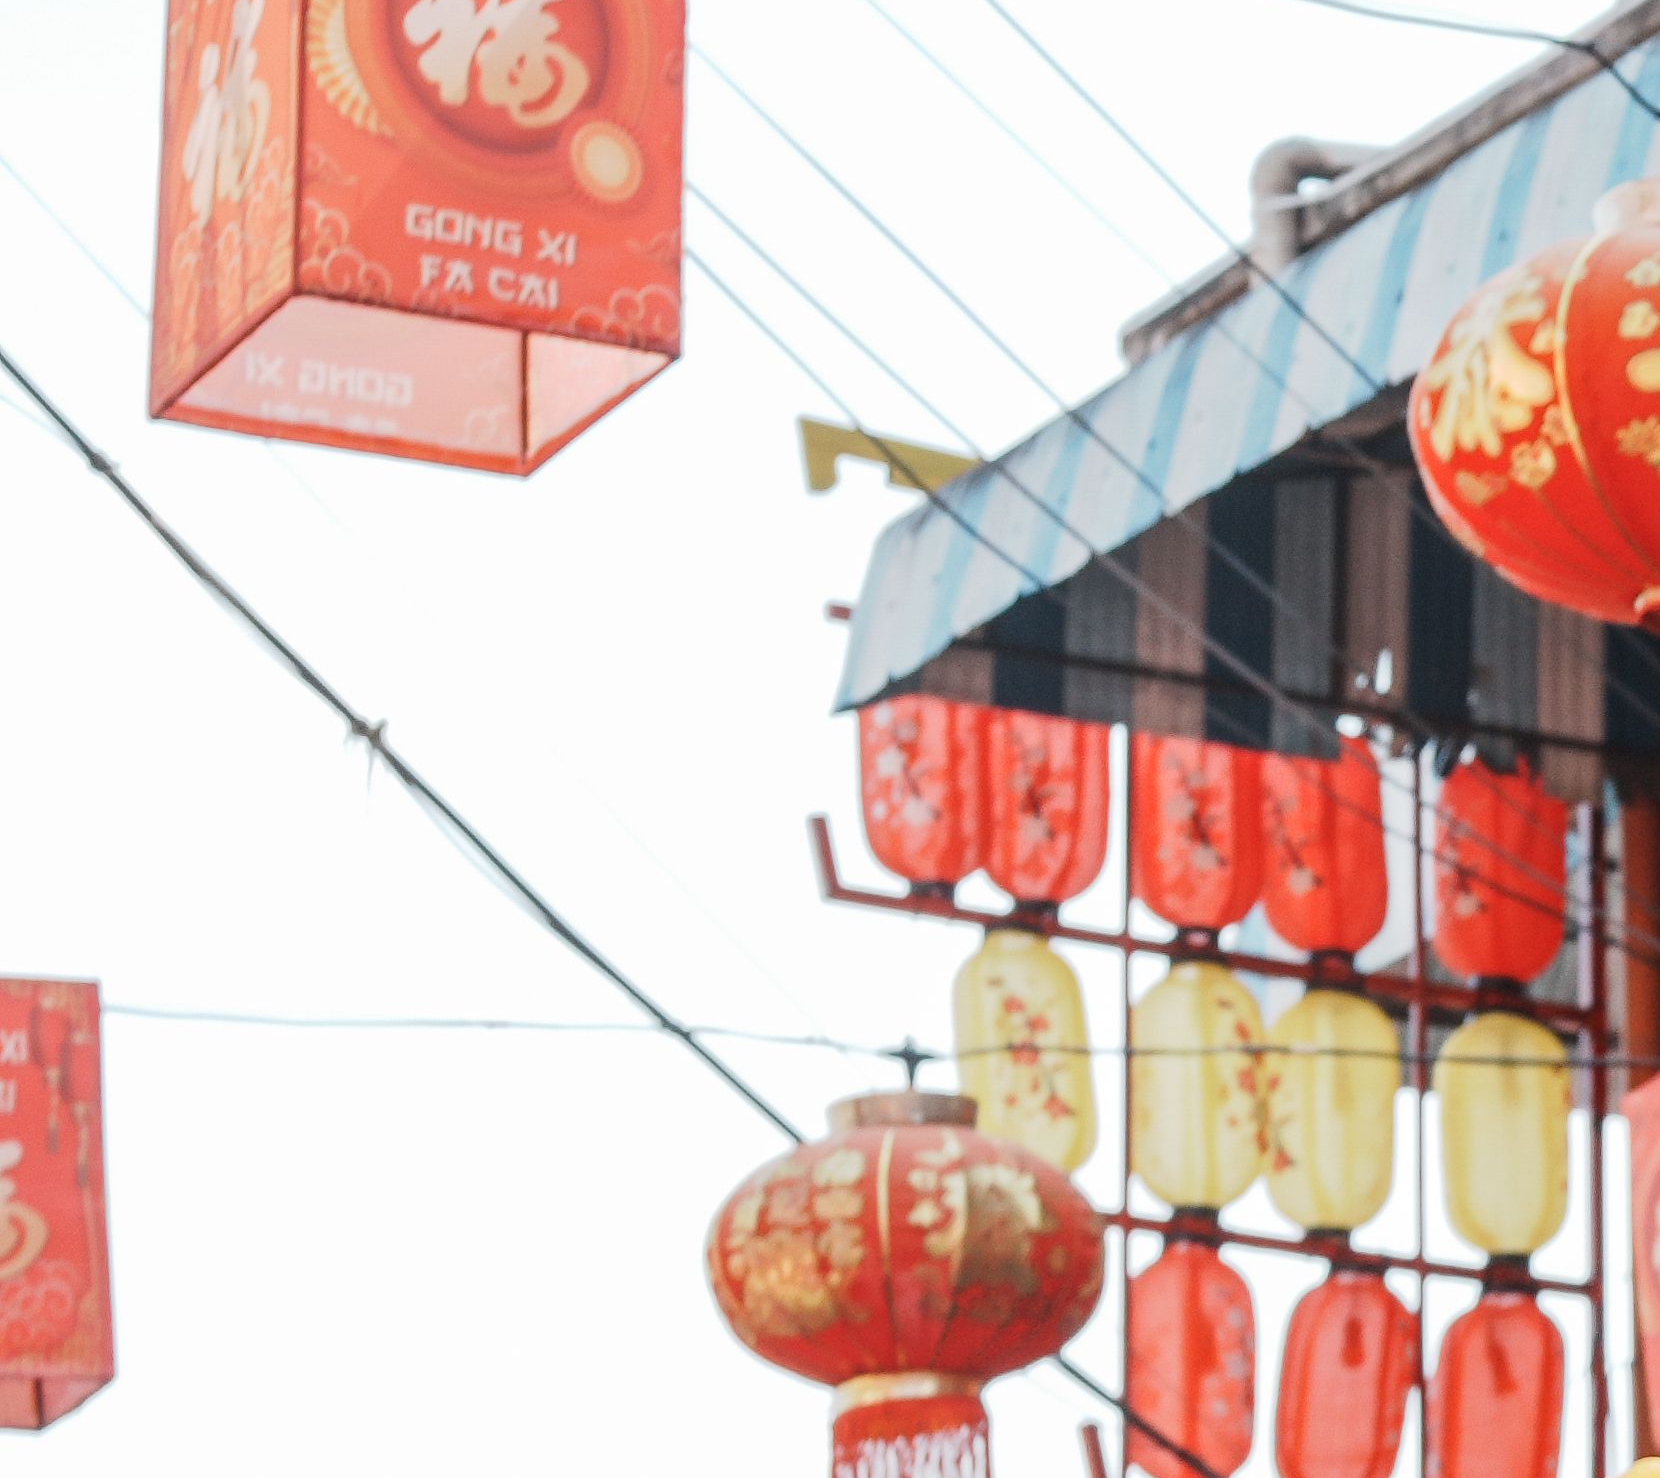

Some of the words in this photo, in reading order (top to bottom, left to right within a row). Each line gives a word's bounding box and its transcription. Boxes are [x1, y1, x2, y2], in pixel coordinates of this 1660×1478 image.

[404, 202, 523, 259] GONG
[535, 227, 579, 268] XI
[418, 255, 475, 295] FA
[487, 266, 560, 312] CAI
